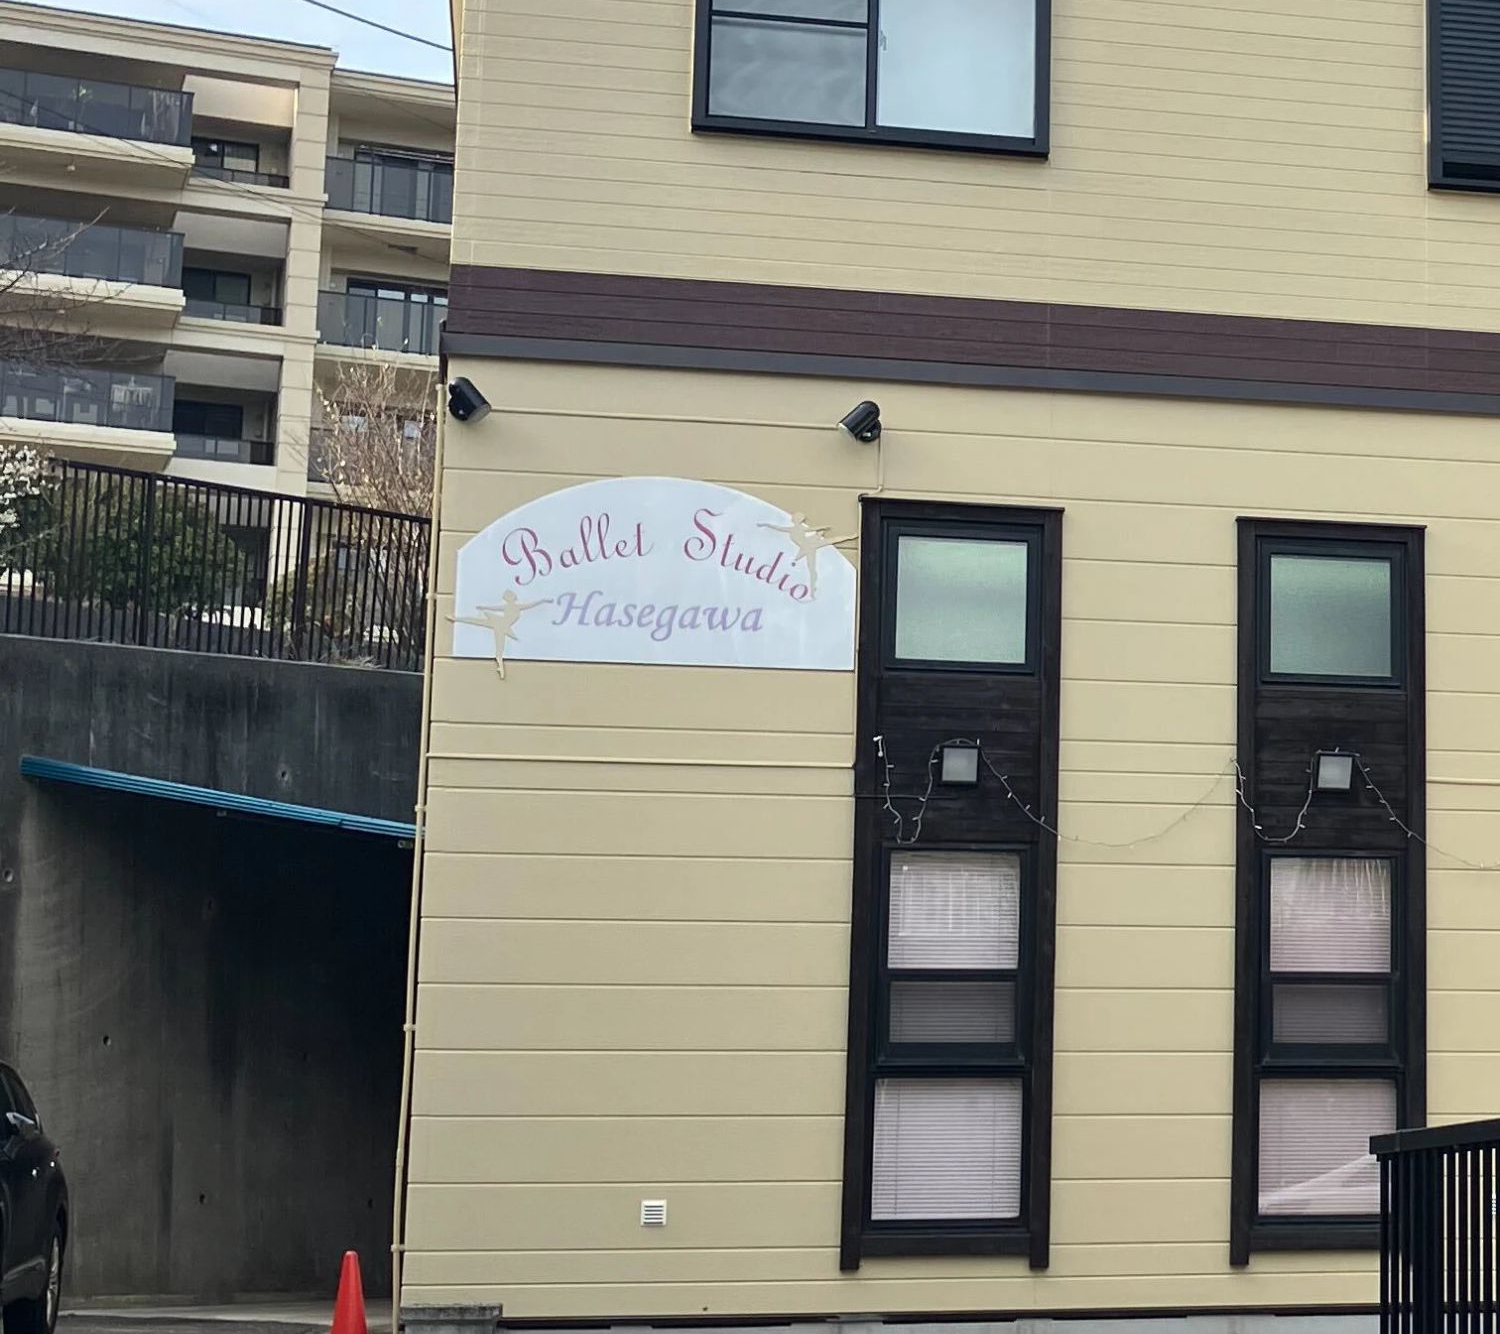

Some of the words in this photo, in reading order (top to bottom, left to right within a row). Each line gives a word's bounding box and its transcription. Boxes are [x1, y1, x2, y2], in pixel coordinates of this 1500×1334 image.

[502, 513, 653, 586] Ballet
[684, 508, 814, 602] Studio
[552, 590, 763, 642] Hasegawa
